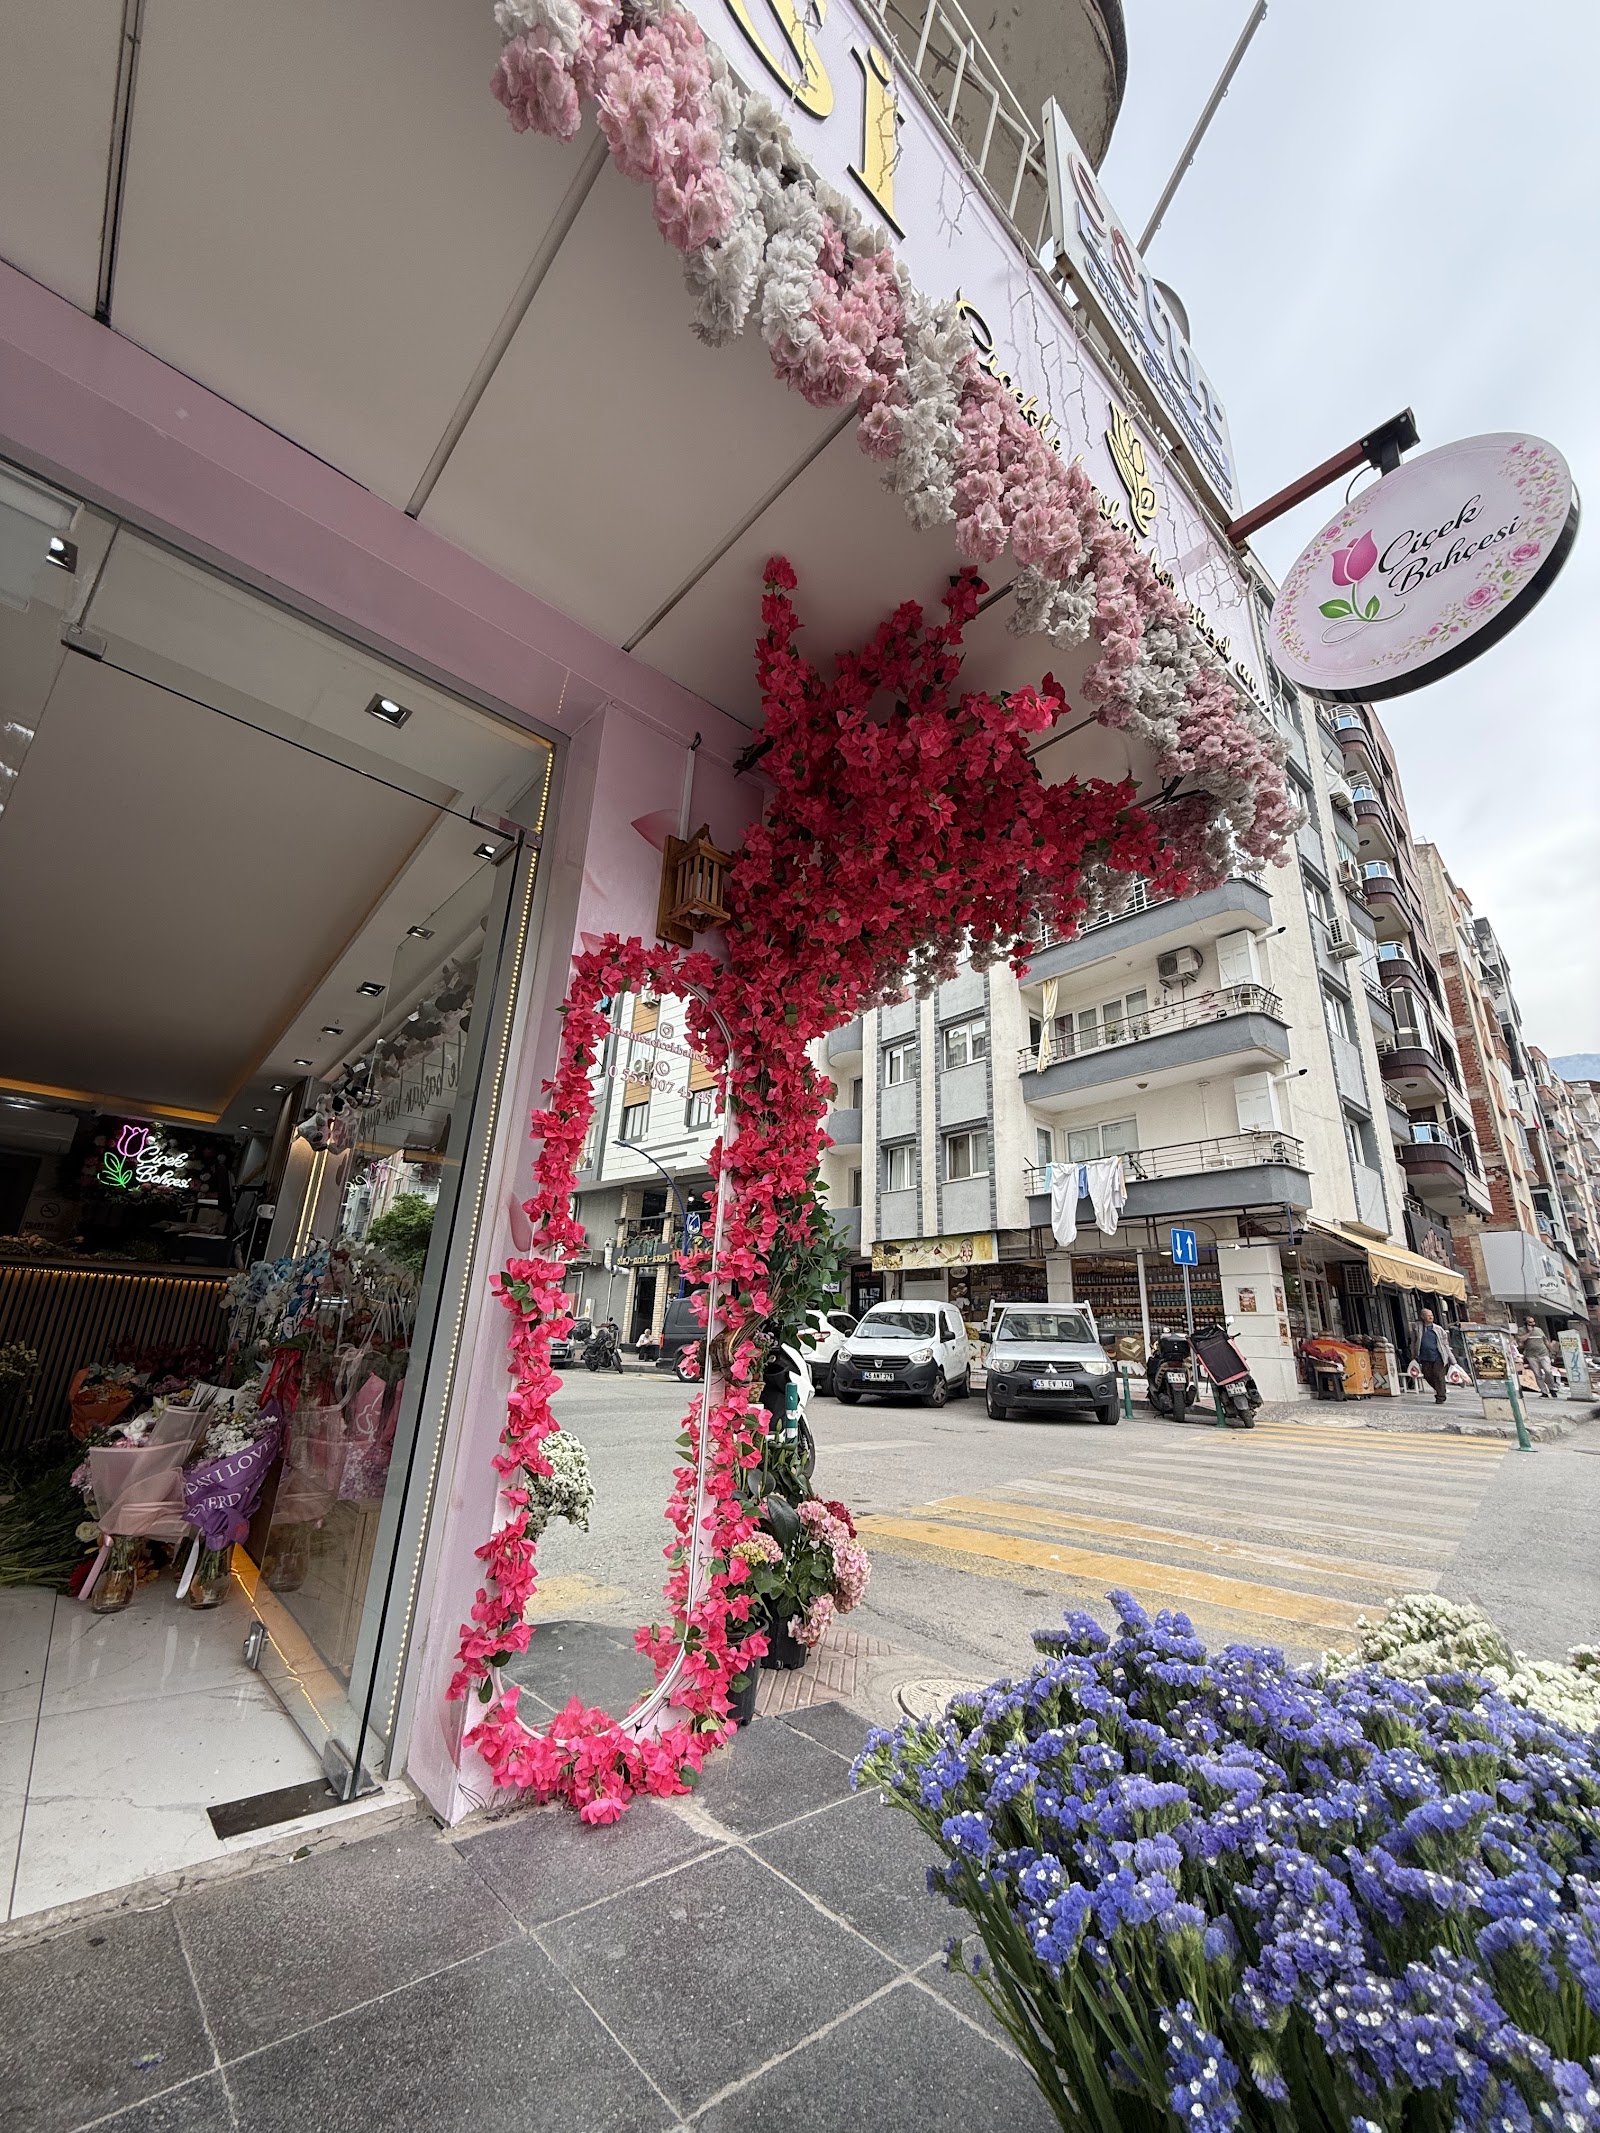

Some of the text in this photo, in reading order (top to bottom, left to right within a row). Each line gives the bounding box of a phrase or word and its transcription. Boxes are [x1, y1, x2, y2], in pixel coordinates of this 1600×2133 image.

[1378, 494, 1485, 575] Çiçek
[1388, 516, 1524, 597] Bahçesi
[620, 1068, 648, 1087] 554
[650, 1076, 675, 1094] 007
[678, 1086, 693, 1099] 45
[696, 1091, 712, 1105] 45
[136, 1146, 189, 1168] Çiçek
[136, 1165, 192, 1189] Bahçesi
